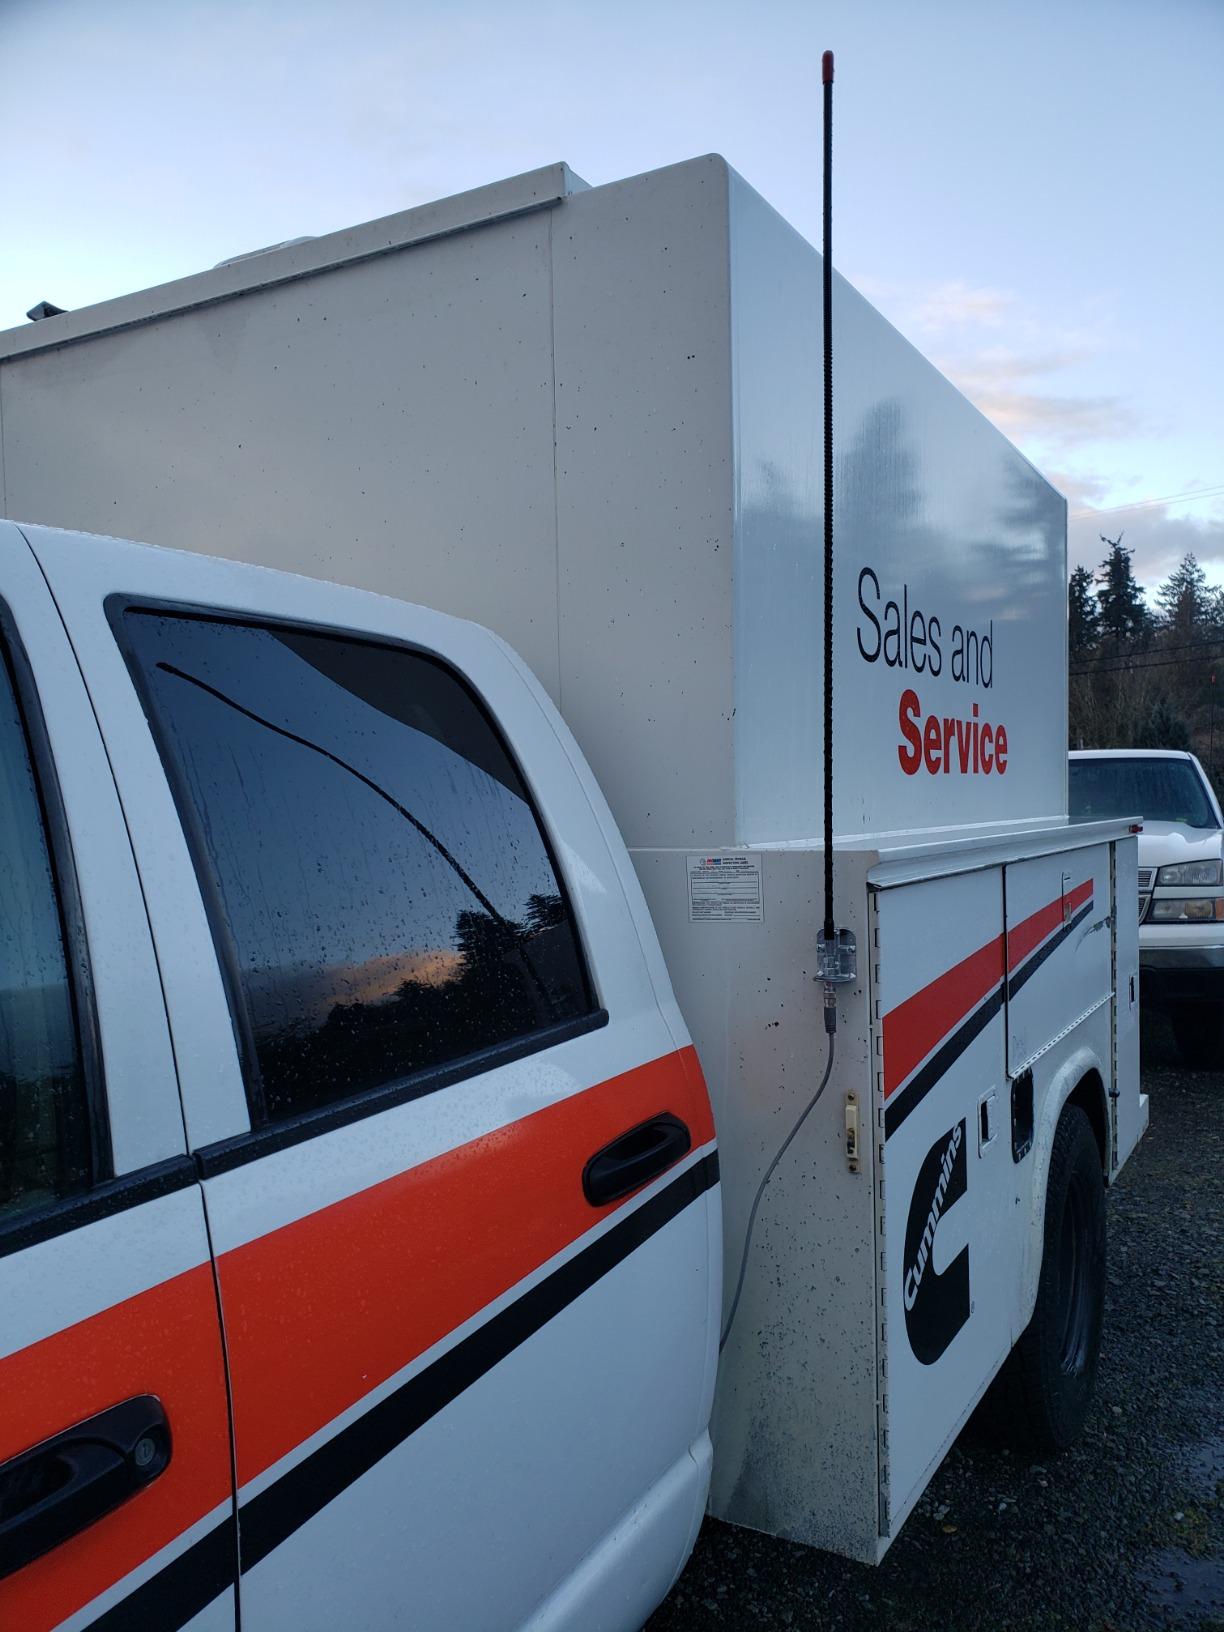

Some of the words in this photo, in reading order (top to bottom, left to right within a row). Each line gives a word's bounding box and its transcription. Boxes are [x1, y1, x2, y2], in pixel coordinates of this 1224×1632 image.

[857, 567, 942, 677] Sales
[952, 620, 993, 688] and
[898, 689, 1008, 775] Service
[904, 1123, 962, 1311] Cummins
